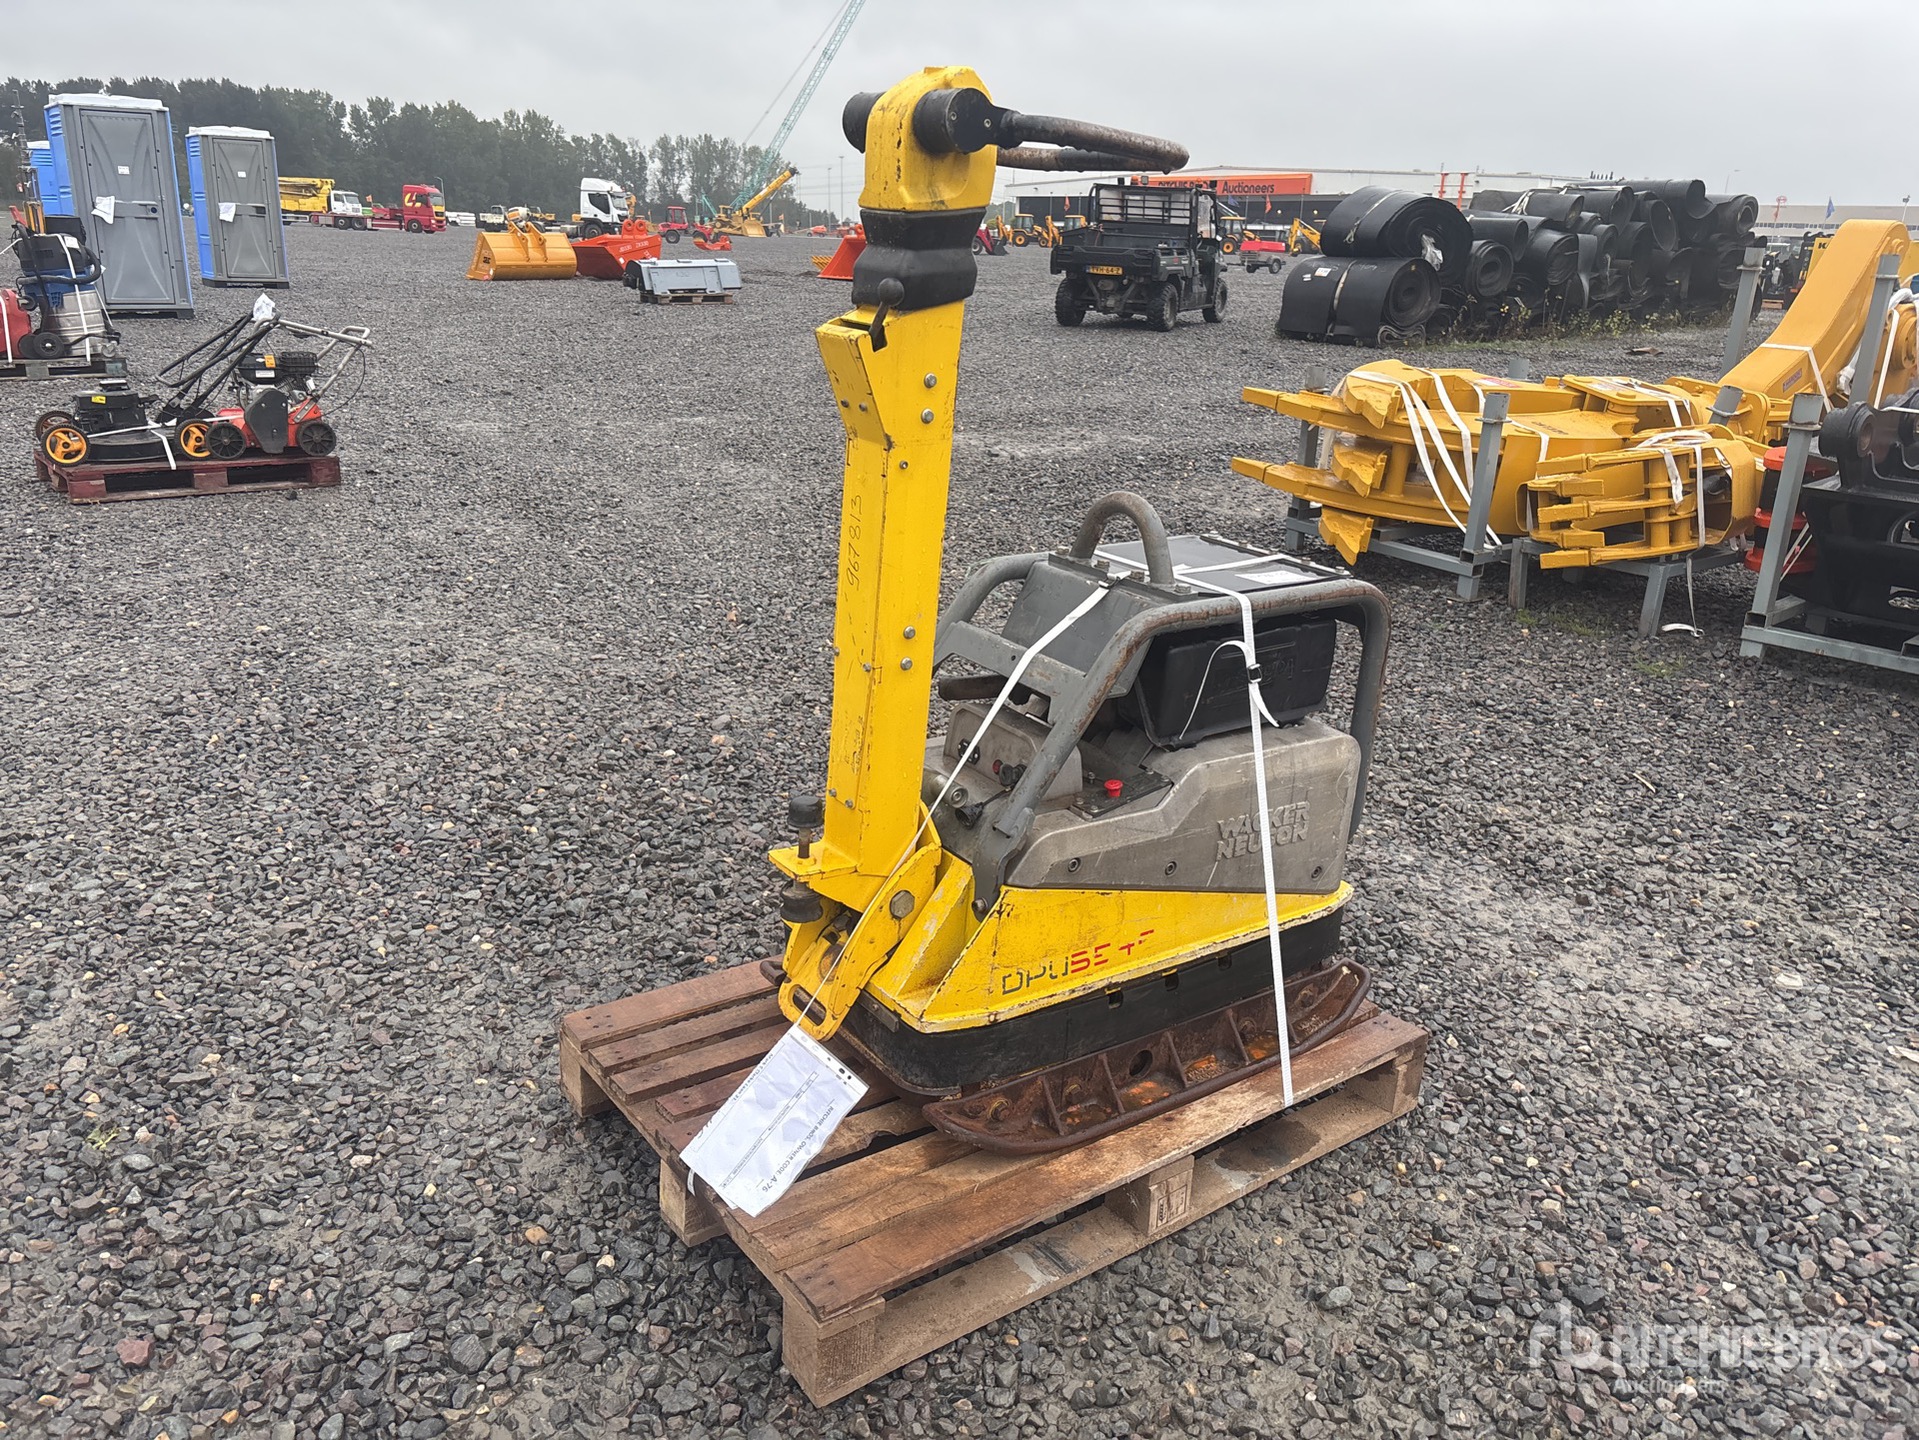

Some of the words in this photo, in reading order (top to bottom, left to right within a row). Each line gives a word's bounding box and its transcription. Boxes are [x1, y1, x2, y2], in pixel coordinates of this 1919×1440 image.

[1221, 181, 1275, 194] Auctioneers
[846, 494, 862, 591] 967813
[817, 1106, 834, 1126] RITCHIE
[788, 1141, 807, 1161] OWNER
[762, 1175, 777, 1192] A-76
